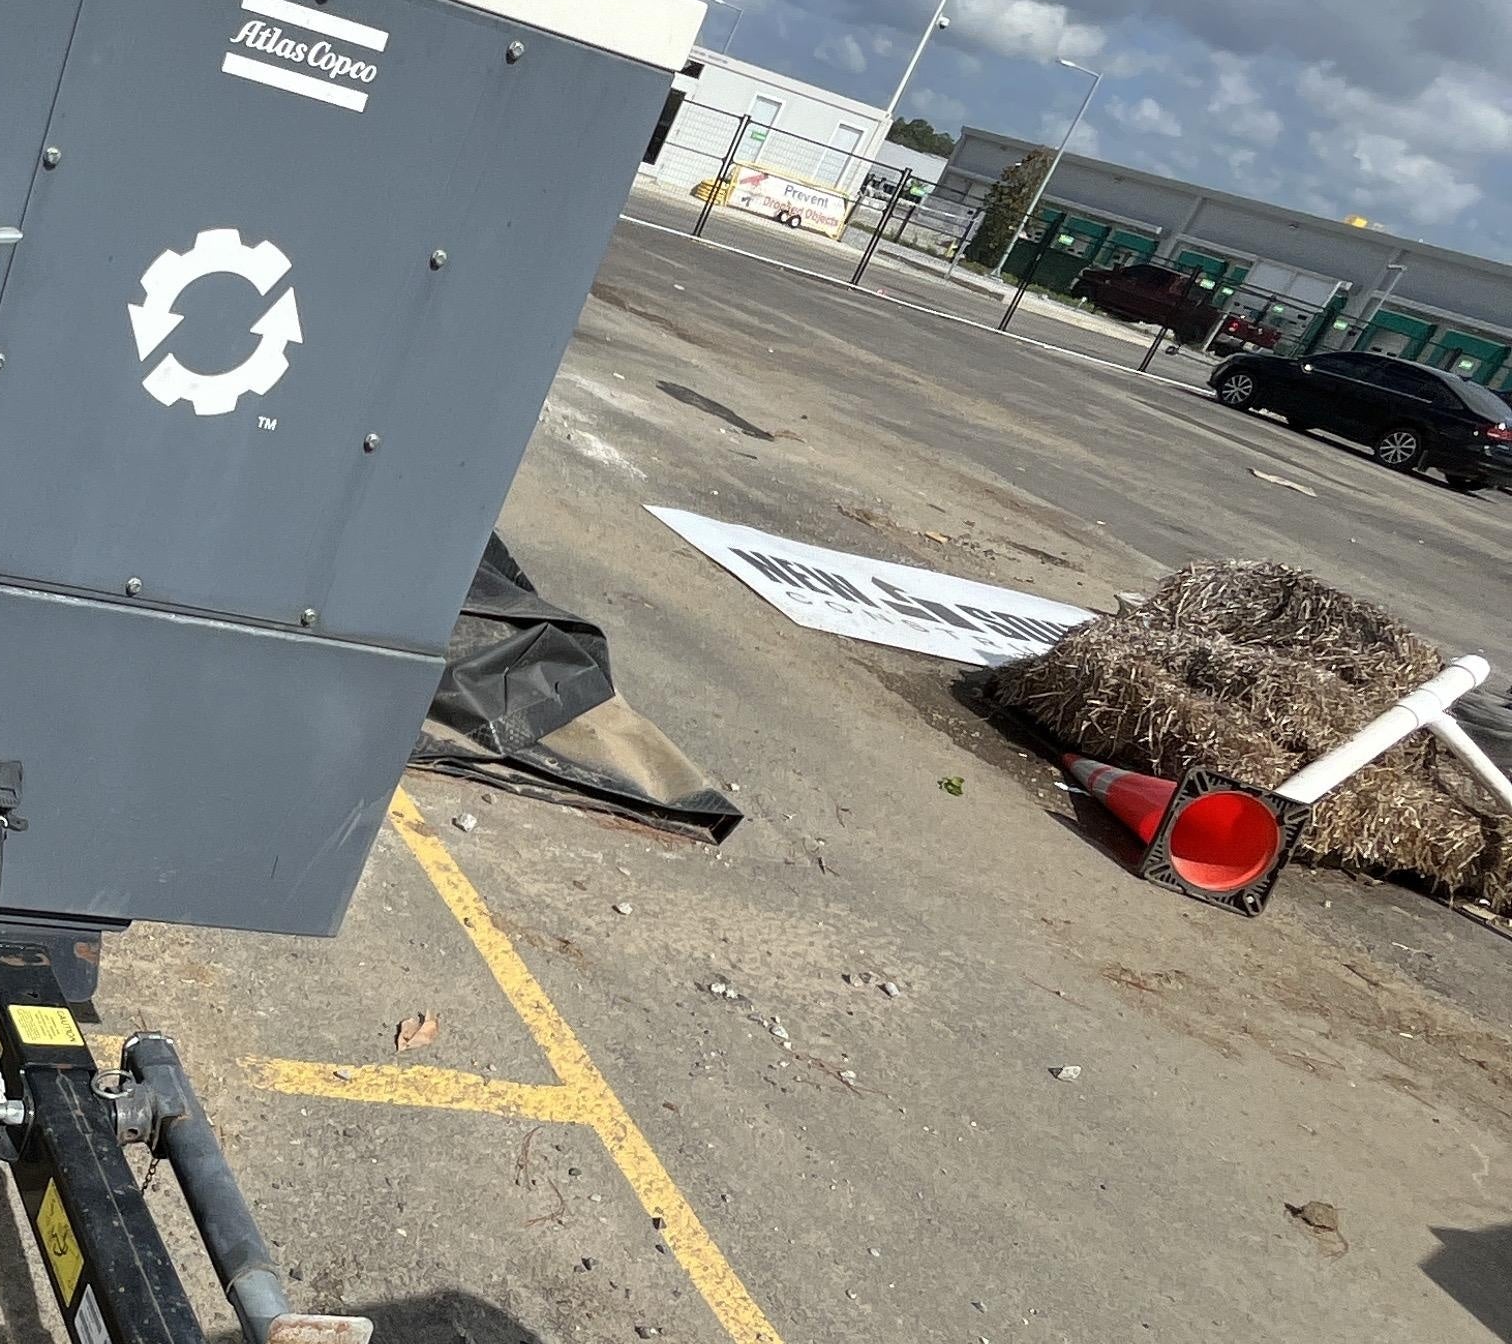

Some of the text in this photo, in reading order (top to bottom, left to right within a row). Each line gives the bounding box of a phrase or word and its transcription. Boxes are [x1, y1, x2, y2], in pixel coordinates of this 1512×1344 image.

[784, 184, 829, 209] Prevent
[257, 416, 278, 432] TM
[728, 546, 1068, 645] NEW SOU
[785, 590, 1050, 658] CONSTRU
